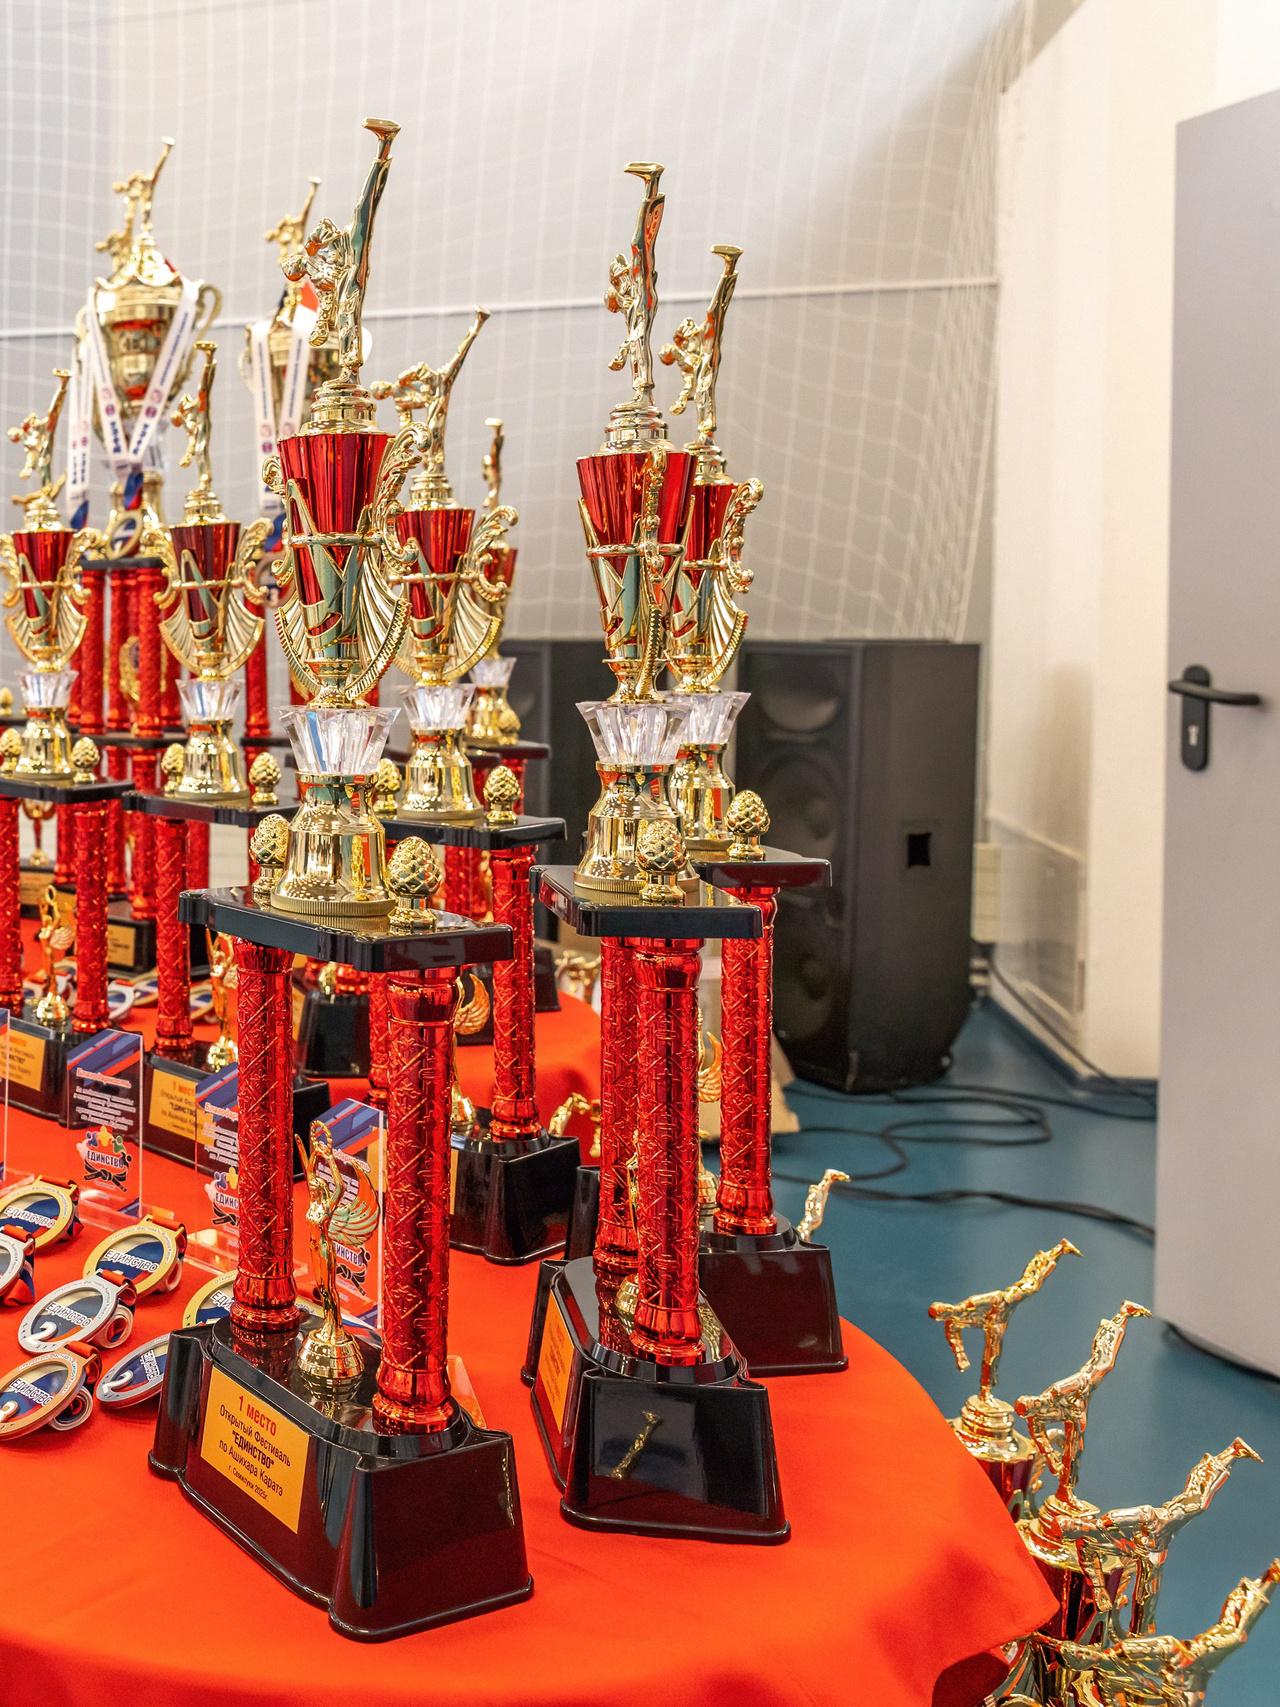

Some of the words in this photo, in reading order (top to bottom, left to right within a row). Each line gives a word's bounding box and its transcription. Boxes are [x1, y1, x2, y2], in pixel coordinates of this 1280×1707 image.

[104, 1249, 159, 1273] ЕДИНСТВО
[47, 1301, 93, 1328] ЕДИНСТВО
[24, 1321, 58, 1346] 2
[238, 1395, 244, 1411] 1
[246, 1403, 277, 1436] место
[219, 1404, 253, 1438] Открытый
[254, 1431, 291, 1467] Фестиваль
[232, 1431, 275, 1469] "ЕДИНСТВО"
[218, 1440, 228, 1453] по
[228, 1444, 258, 1476] Ашихара
